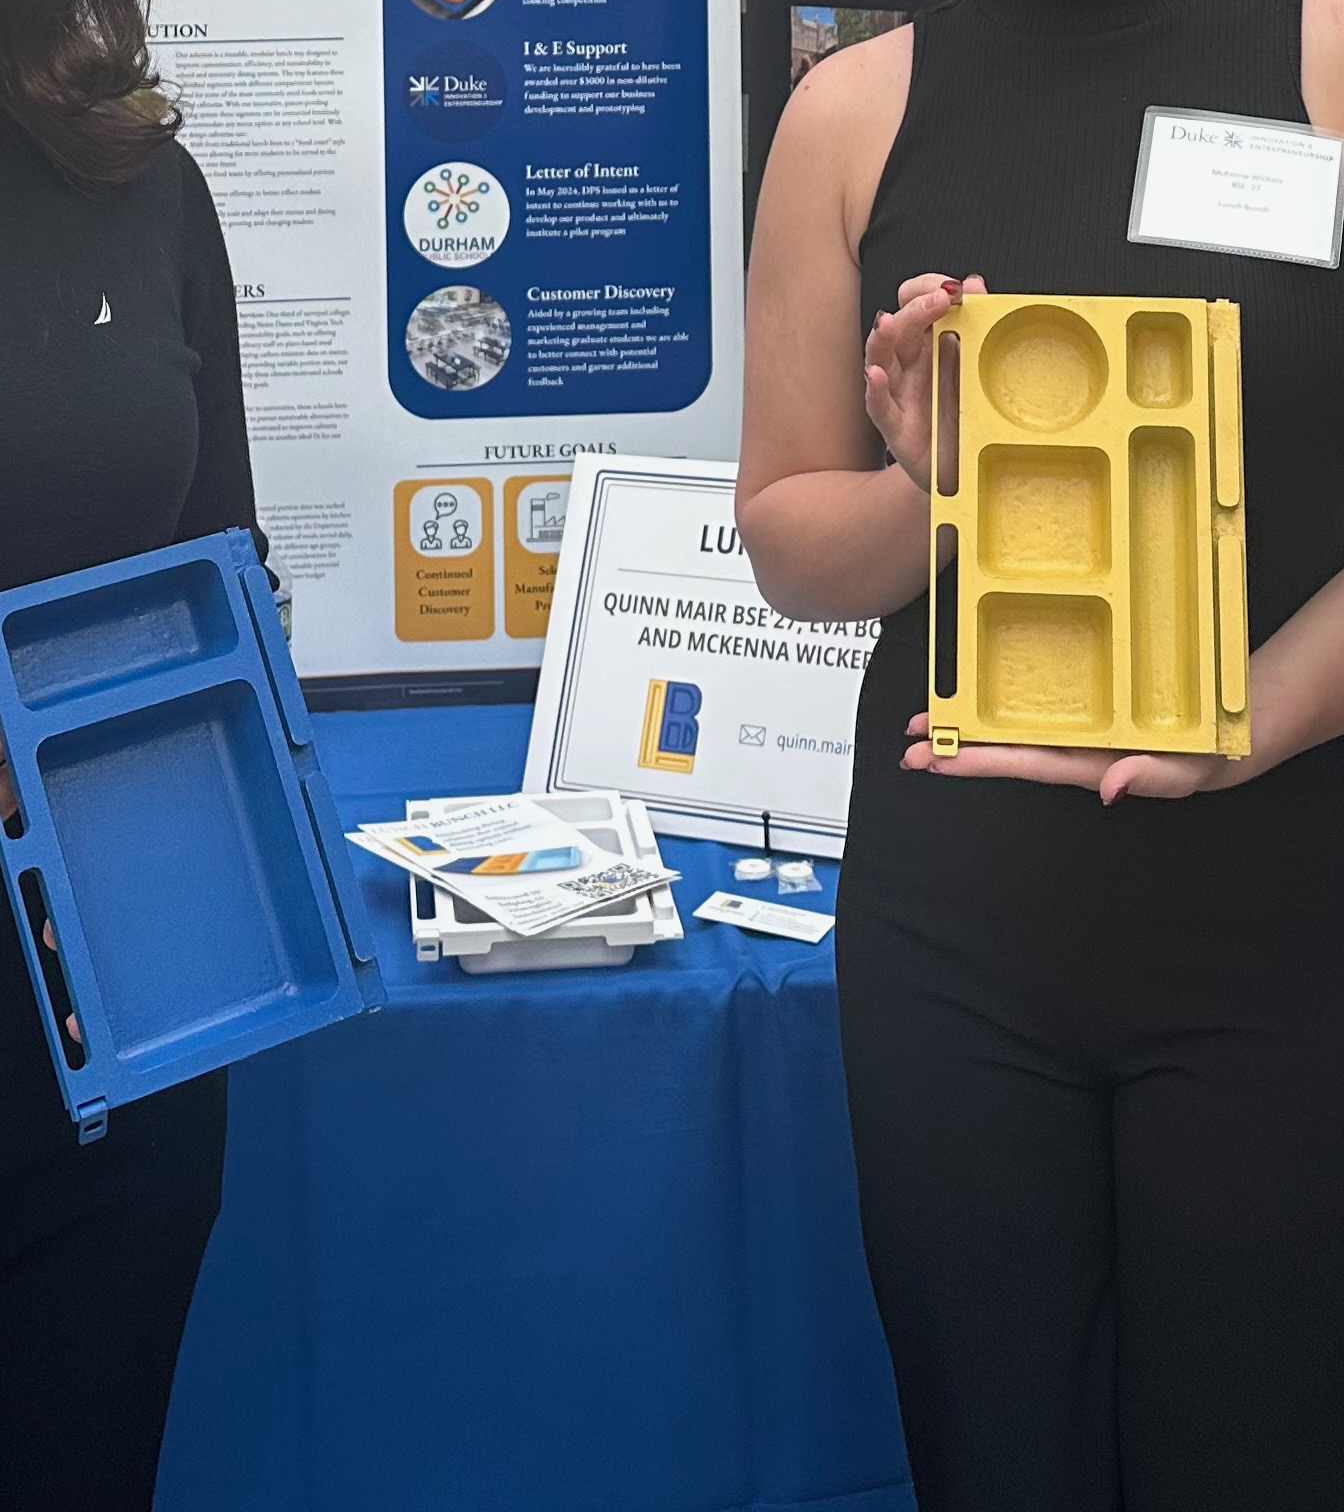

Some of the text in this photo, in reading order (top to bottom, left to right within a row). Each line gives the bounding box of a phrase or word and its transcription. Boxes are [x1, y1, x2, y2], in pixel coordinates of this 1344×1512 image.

[523, 41, 627, 57] I & E Support
[444, 74, 488, 92] Duke
[1170, 125, 1219, 145] Duke
[526, 163, 639, 179] Letter of Intent
[419, 237, 495, 252] DURHAM
[526, 284, 675, 301] Customer Discovery
[484, 442, 618, 460] FUTURE GOALS
[700, 524, 744, 556] LU
[415, 566, 473, 581] Continued
[418, 586, 471, 599] Customer
[419, 602, 471, 618] Discovery
[603, 592, 670, 619] QUINN
[676, 600, 727, 625] MAIR
[855, 620, 884, 640] BO
[638, 627, 681, 649] AND
[687, 631, 790, 663] MCKENNA
[776, 731, 853, 757] quinn.mair
